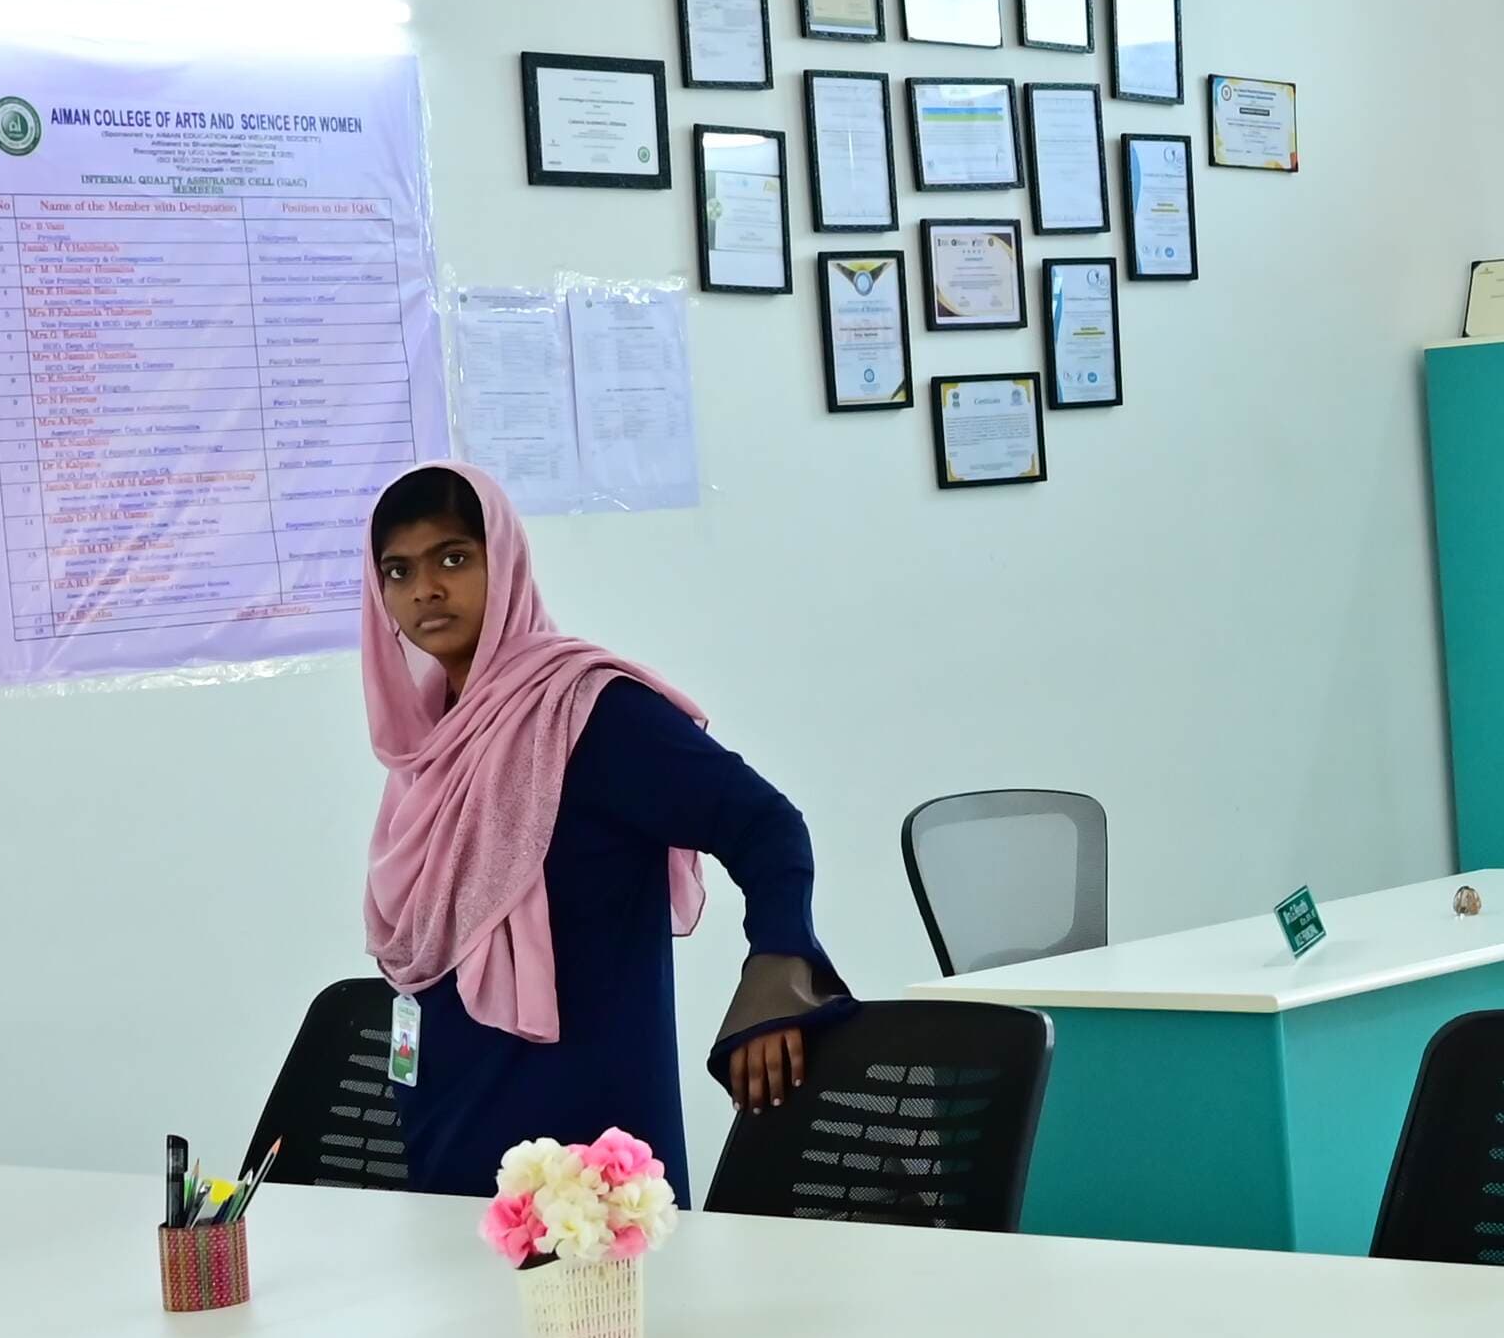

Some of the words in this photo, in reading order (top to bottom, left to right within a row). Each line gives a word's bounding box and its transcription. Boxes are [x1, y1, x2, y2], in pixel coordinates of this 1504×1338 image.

[50, 108, 91, 126] AIMAN
[94, 109, 153, 128] COLLEGE
[156, 111, 172, 128] OF
[175, 112, 207, 129] ARTS
[210, 113, 235, 130] AND
[241, 113, 291, 131] SCIENCE
[294, 115, 317, 132] FOR
[319, 116, 363, 134] WOMEN
[81, 174, 136, 185] INTERNAL
[138, 175, 183, 185] QUALITY
[186, 177, 246, 187] ASSURANCE
[248, 177, 275, 187] CELL
[172, 186, 224, 194] MEMBERS
[39, 200, 72, 211] Name
[74, 200, 86, 211] of
[87, 200, 105, 212] the
[108, 201, 151, 212] Member
[154, 202, 176, 212] with
[179, 202, 237, 214] Designation
[282, 203, 320, 213] Position
[334, 203, 349, 213] the
